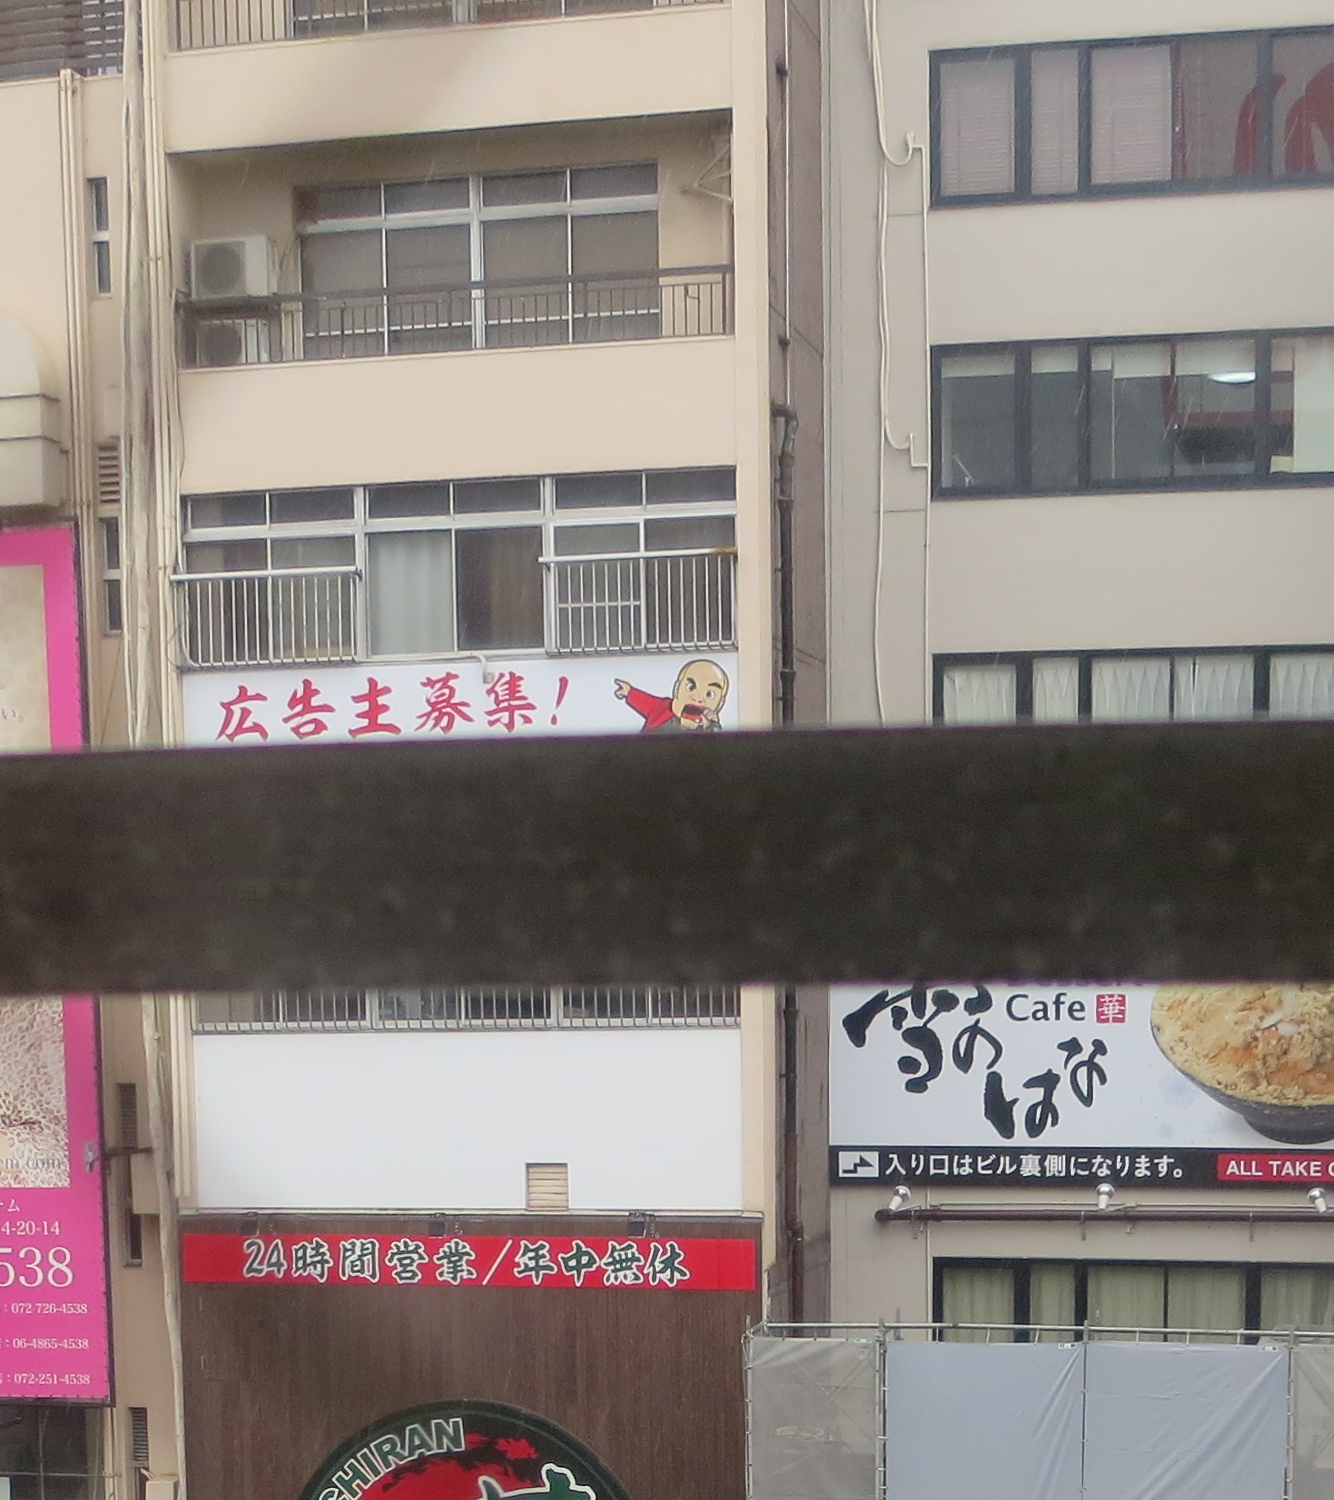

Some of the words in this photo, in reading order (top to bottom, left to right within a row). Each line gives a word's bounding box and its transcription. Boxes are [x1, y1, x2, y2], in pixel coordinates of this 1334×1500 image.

[215, 671, 570, 743] 広告主募集！
[1006, 993, 1086, 1021] Cafe
[1098, 995, 1126, 1023] 華
[884, 1153, 1184, 1179] 入り口はビル裏側になります。
[1225, 1160, 1263, 1177] ALL
[1269, 1161, 1322, 1178] TAKE
[1, 1221, 61, 1237] 4-20-14
